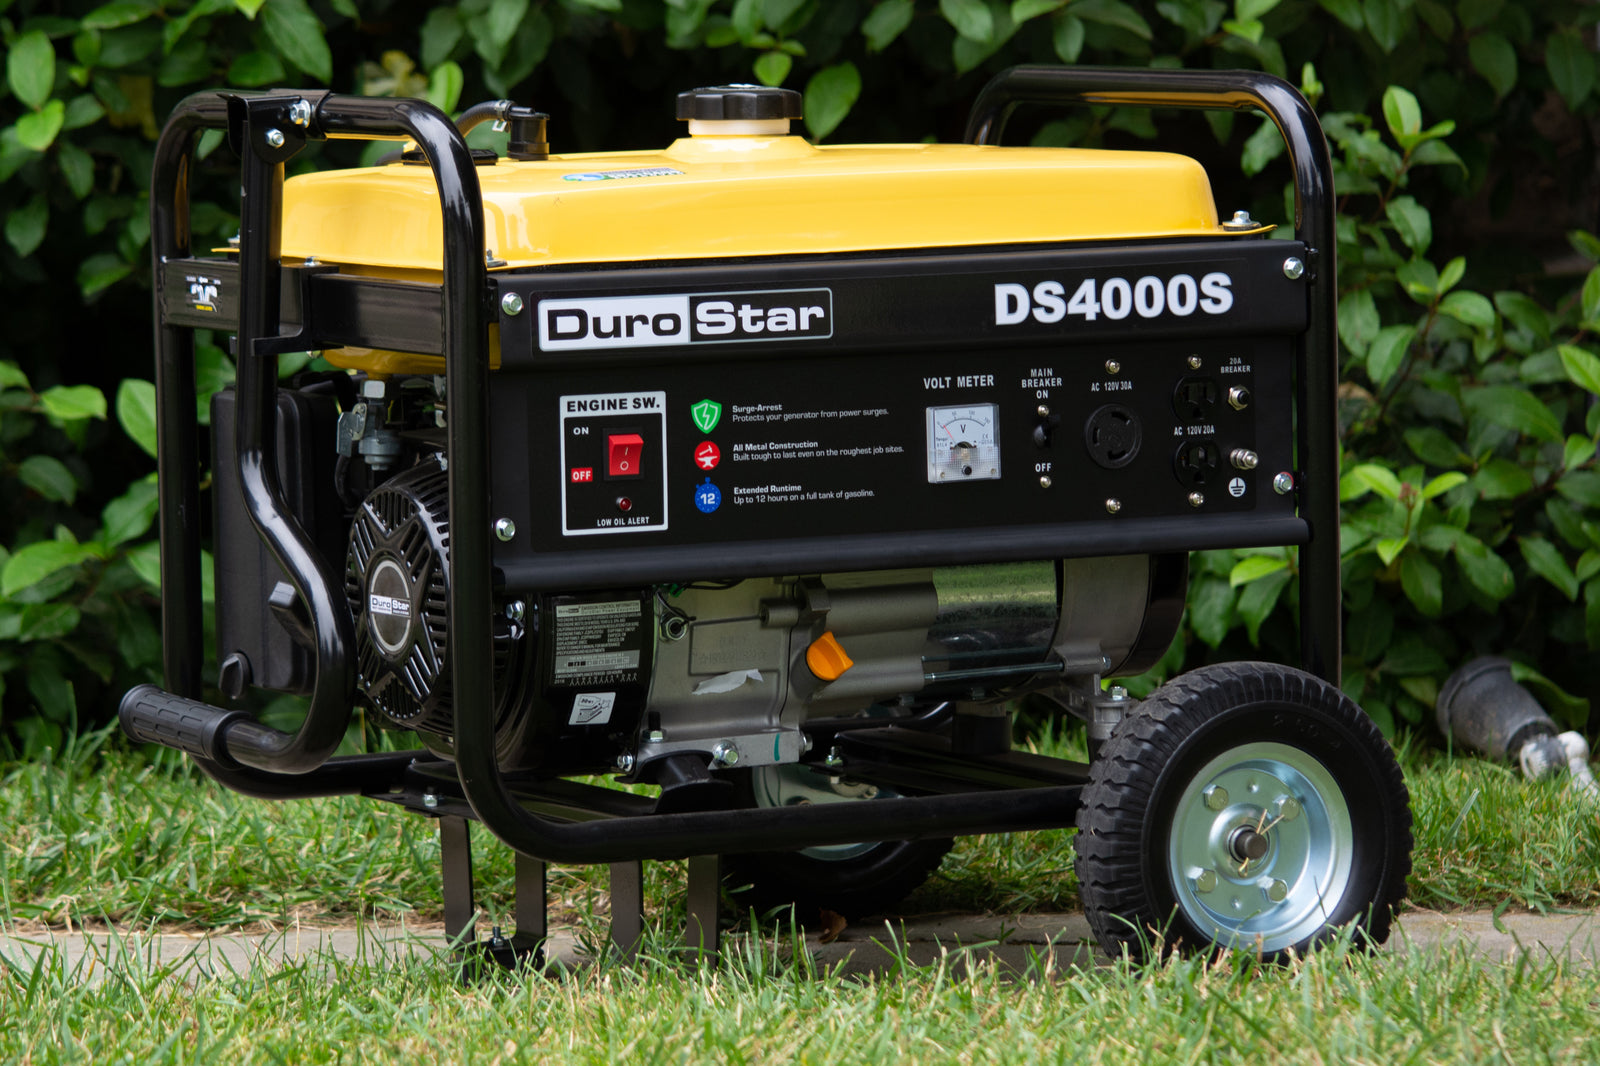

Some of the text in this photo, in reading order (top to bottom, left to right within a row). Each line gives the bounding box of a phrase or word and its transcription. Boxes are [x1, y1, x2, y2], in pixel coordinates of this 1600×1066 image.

[995, 272, 1234, 325] DS4000S
[1229, 357, 1242, 365] 20A
[1030, 367, 1053, 378] MAIN
[1220, 364, 1251, 374] BREAKER
[924, 375, 994, 389] VOLT METER
[1022, 376, 1062, 388] BREAKER
[1090, 380, 1133, 392] AC 120V 30A
[1036, 389, 1049, 400] ON
[567, 397, 659, 412] ENGINE SW.
[732, 403, 783, 415] Surge-Arrest
[732, 408, 889, 423] Protects your generator from power surges.
[573, 426, 589, 436] ON
[960, 424, 966, 433] V
[1173, 424, 1215, 436] AC 120V 20A
[732, 440, 819, 452] All Metal Construction
[733, 452, 750, 462] Built
[750, 451, 772, 462] tough
[782, 450, 797, 459] last
[797, 450, 815, 458] even
[825, 448, 839, 457] the
[839, 446, 873, 457] roughest
[872, 445, 884, 456] job
[884, 445, 905, 454] sites.
[1034, 462, 1052, 473] OFF
[572, 470, 591, 481] OFF
[733, 484, 802, 495] Extended Runtime
[701, 493, 715, 504] 12
[733, 496, 745, 506] Up
[745, 496, 754, 504] to
[755, 494, 766, 503] 12
[767, 494, 789, 503] hours
[806, 491, 818, 500] full
[818, 491, 835, 500] tank
[835, 490, 844, 499] of
[844, 489, 875, 500] gasoline.
[596, 516, 651, 527] LOW OIL ALERT
